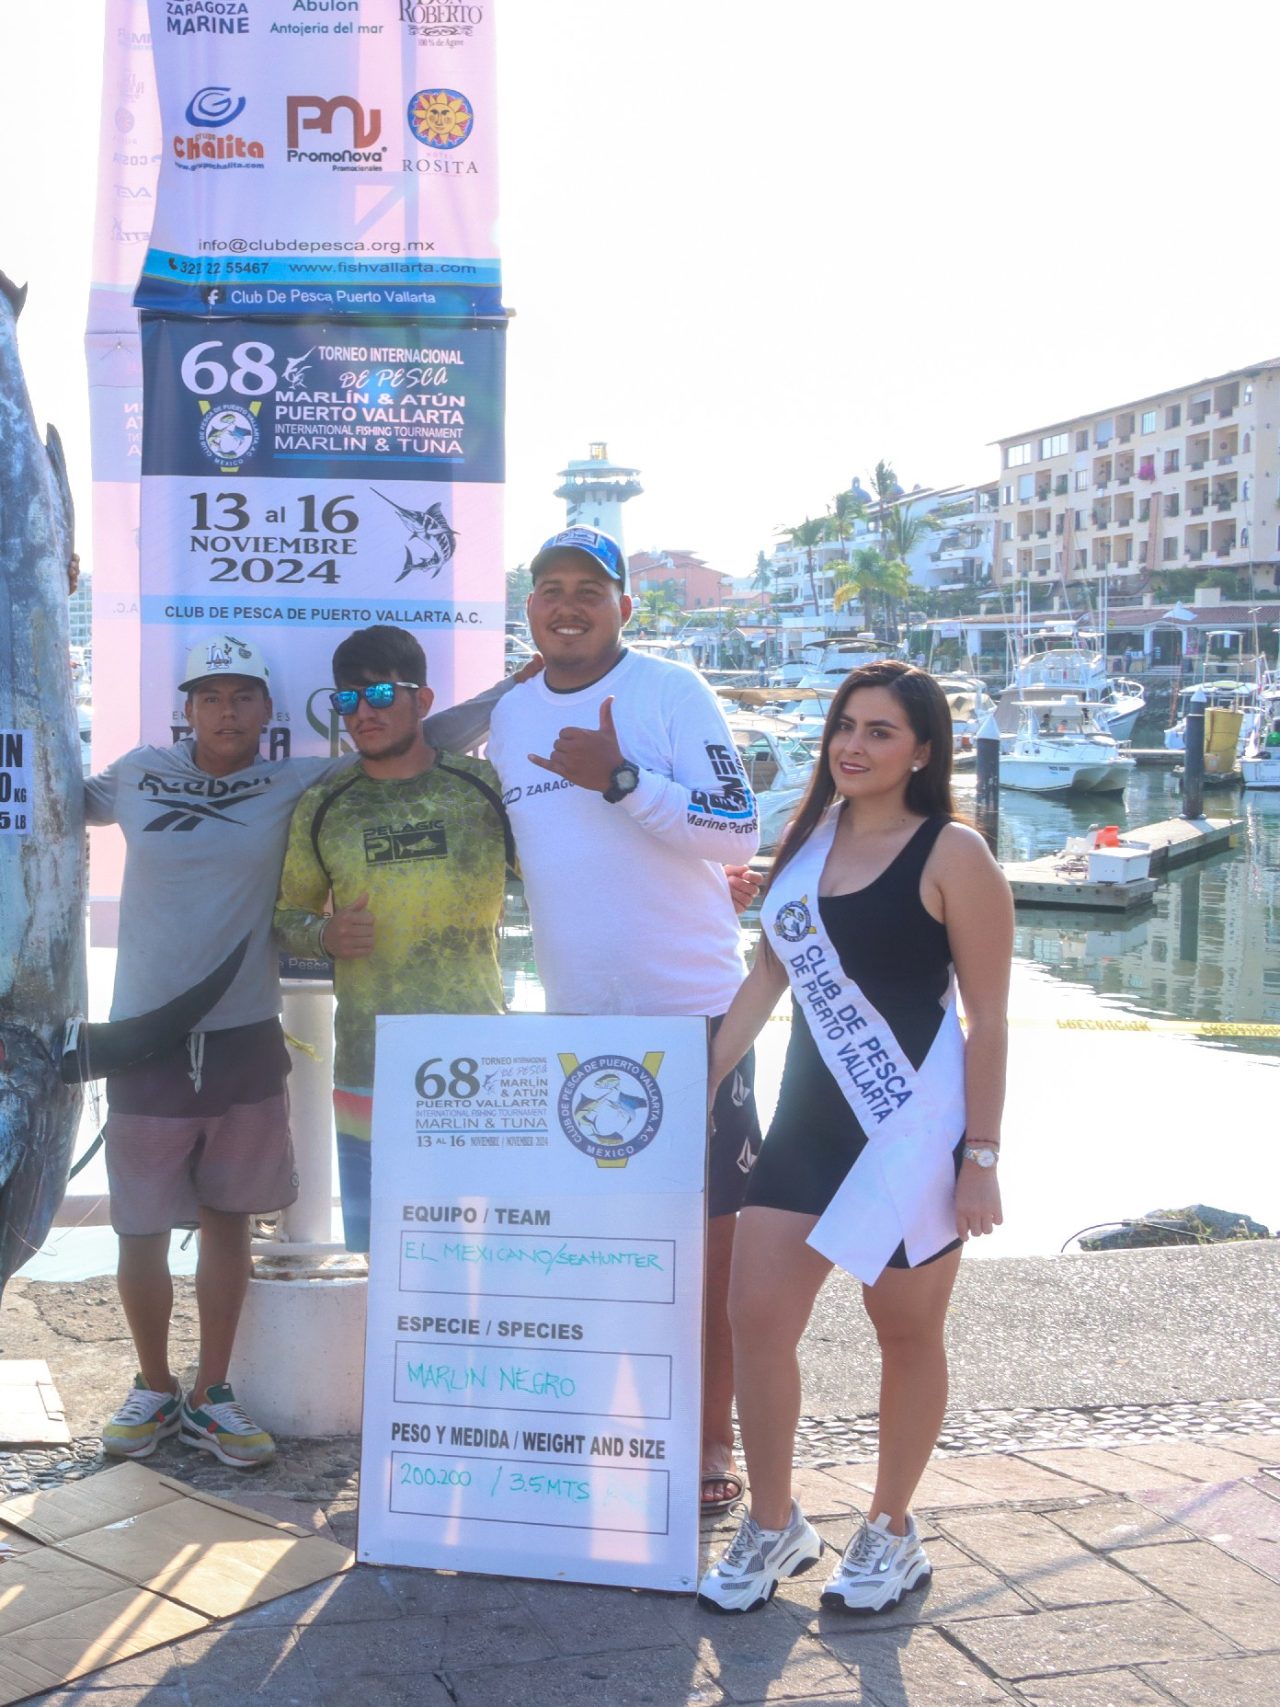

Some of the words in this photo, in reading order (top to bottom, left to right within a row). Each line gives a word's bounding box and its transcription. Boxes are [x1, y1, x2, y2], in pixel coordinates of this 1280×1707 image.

[167, 2, 249, 16] ZARAGOZA
[399, 0, 482, 24] ROBERTO
[167, 16, 250, 35] MARINE
[333, 22, 353, 33] del
[358, 25, 384, 33] mar
[174, 134, 264, 160] Chalita
[402, 159, 479, 174] ROSITA
[198, 238, 435, 253] info@clubdepesca.org.mx
[226, 262, 269, 273] 55467
[289, 262, 476, 274] www.fishvallarta.com
[231, 290, 262, 304] Club
[267, 289, 287, 303] De
[290, 289, 333, 303] Pesca
[336, 289, 381, 303] Puerto
[384, 290, 436, 304] Vallarta
[319, 346, 368, 361] TORNEO
[371, 347, 464, 365] INTERNACIONAL
[181, 341, 277, 396] 68
[339, 370, 369, 389] DE
[275, 390, 369, 404] MARLÍN
[378, 393, 394, 405] &
[401, 393, 465, 408] ATÚN
[275, 406, 357, 421] PUERTO
[362, 408, 464, 425] VALLARTA
[275, 424, 354, 435] INTERNATIONAL
[356, 426, 392, 436] FISHING
[395, 426, 463, 439] TOURNAMENT
[275, 436, 366, 451] MARLIN
[374, 438, 390, 451] &
[397, 439, 463, 454] TUNA
[190, 492, 250, 533] 13
[265, 506, 285, 523] al
[297, 494, 359, 534] 16
[190, 536, 358, 555] NOVIEMBRE
[209, 558, 341, 584] 2024
[165, 606, 205, 619] CLUB
[210, 607, 229, 619] DE
[233, 607, 283, 621] PESCA
[288, 608, 305, 621] DE
[311, 609, 371, 622] PUERTO
[376, 610, 451, 623] VALLARTA
[455, 611, 482, 624] A.C.
[14, 788, 27, 803] KG
[15, 815, 27, 829] LB
[363, 820, 445, 839] PELAGIC
[687, 813, 727, 831] Marine
[806, 945, 841, 1000] CLUB
[837, 1004, 867, 1036] DE
[859, 1037, 913, 1109] PESCA
[790, 954, 810, 978] DE
[802, 982, 845, 1041] PUERTO
[836, 1042, 894, 1124] VALLARTA
[584, 1061, 598, 1073] DE
[600, 1059, 640, 1074] PUERTO
[415, 1057, 481, 1099] 68
[481, 1057, 511, 1065] TORNEO
[562, 1072, 585, 1101] PESCA
[501, 1089, 509, 1097] &
[416, 1100, 472, 1108] PUERTO
[476, 1099, 548, 1107] VALLARTA
[561, 1103, 569, 1116] DE
[415, 1118, 479, 1129] MARLIN
[484, 1118, 495, 1129] &
[501, 1118, 548, 1128] TUNA
[564, 1119, 582, 1143] CLUB
[417, 1136, 432, 1147] 13
[450, 1136, 465, 1147] 16
[586, 1146, 634, 1158] MEXICO
[402, 1205, 477, 1223] EQUIPO
[483, 1208, 489, 1224] /
[494, 1208, 551, 1226] TEAM
[405, 1242, 439, 1262] EL
[397, 1316, 480, 1335] ESPECIE
[486, 1320, 491, 1336] /
[498, 1320, 583, 1340] SPECIES
[408, 1361, 487, 1393] MARLIN
[500, 1367, 576, 1398] NEGRO
[391, 1422, 431, 1444] PESO
[435, 1425, 446, 1444] Y
[450, 1427, 510, 1449] MEDIDA
[513, 1430, 519, 1450] /
[523, 1432, 586, 1454] WEIGHT
[590, 1435, 624, 1457] AND
[629, 1438, 665, 1460] SIZE
[400, 1463, 471, 1487] 200.200
